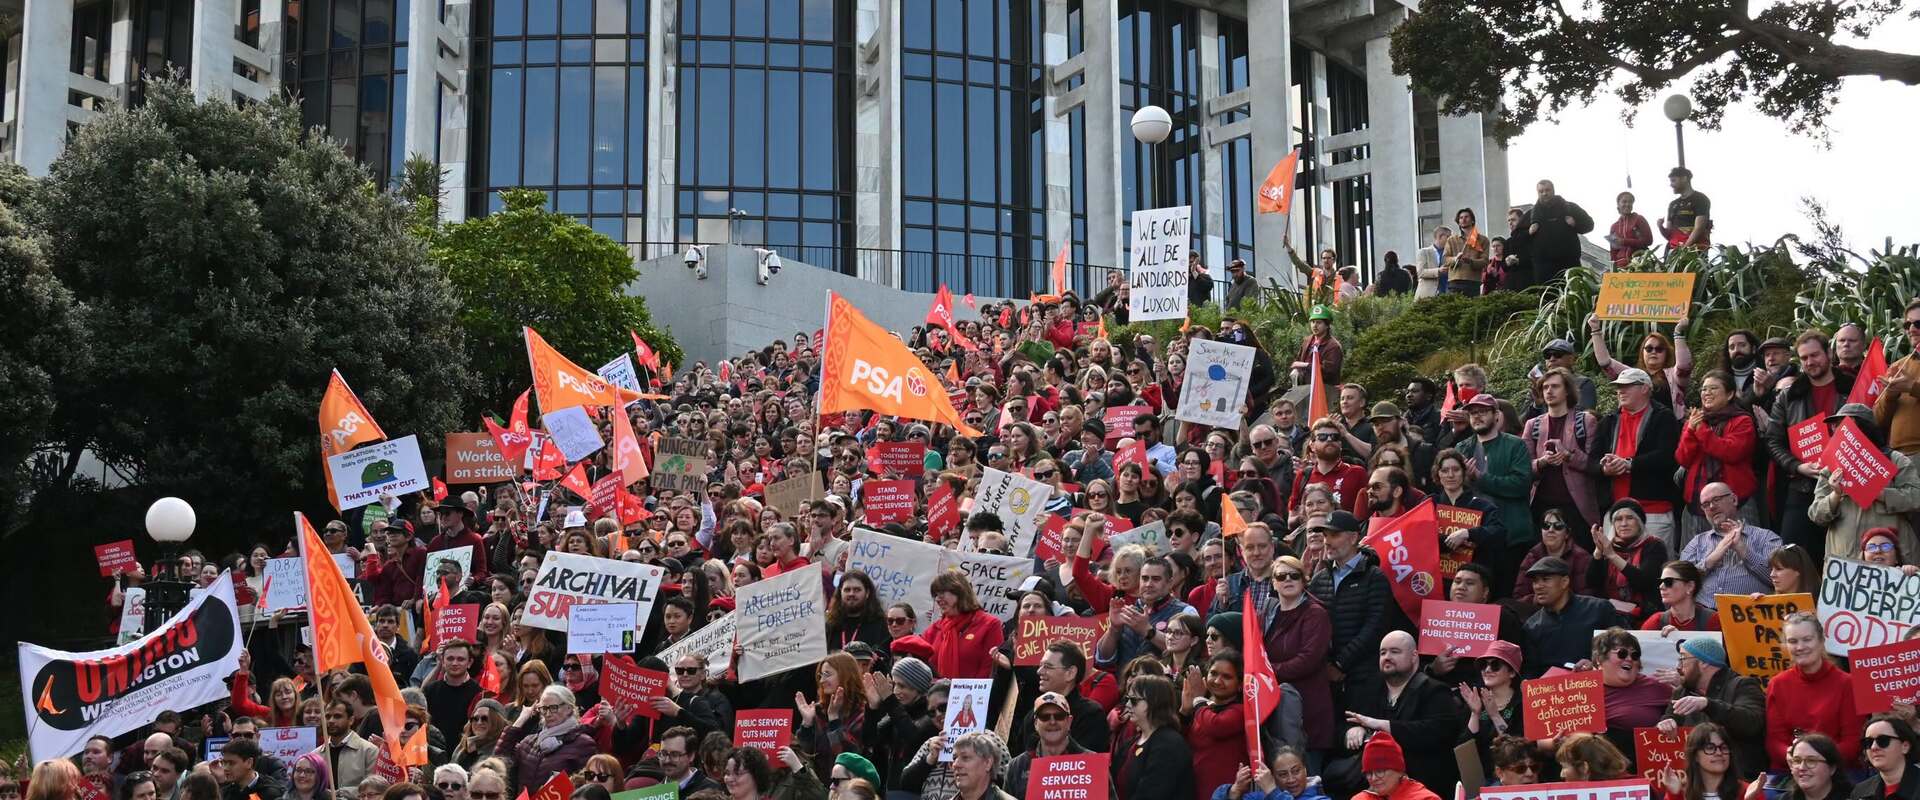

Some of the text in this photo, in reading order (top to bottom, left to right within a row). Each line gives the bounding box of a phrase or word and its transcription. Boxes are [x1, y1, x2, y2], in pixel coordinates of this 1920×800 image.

[1139, 215, 1157, 241] WE
[1138, 244, 1179, 267] ALL BE
[1131, 271, 1187, 289] LANDLORDS
[1142, 296, 1180, 313] LUXON
[558, 370, 596, 400] PSA
[850, 358, 903, 405] PSA
[1799, 422, 1817, 436] PUBLIC
[657, 437, 698, 456] HUNGRY
[1797, 433, 1822, 449] SERVICES
[457, 450, 505, 462] Worke
[1802, 445, 1823, 459] MATTER
[1840, 425, 1890, 479] PUBLIC SERVICE
[1840, 441, 1876, 478] CUTS HURT
[454, 465, 517, 478] on strike!
[1834, 450, 1868, 486] EVERYONE
[653, 472, 676, 489] FAIR
[344, 490, 373, 501] THAT'S
[382, 483, 398, 492] PAY
[938, 493, 953, 507] PUBLIC
[930, 506, 948, 523] SERVICES
[1437, 509, 1481, 528] THE LIBRARY
[854, 541, 891, 559] NOT
[1041, 536, 1061, 551] PUBLIC
[113, 557, 134, 565] SERVICES
[1382, 530, 1414, 583] PSA
[851, 561, 913, 586] ENOUGH
[960, 561, 1007, 581] SPACE
[536, 567, 651, 602] ARCHIVAL
[744, 583, 801, 616] ARCHIVES
[757, 601, 815, 632] FOREVER
[983, 602, 1009, 615] LIKE
[1445, 609, 1476, 619] STAND
[1023, 619, 1049, 638] DIA
[1051, 623, 1096, 640] underpays
[1427, 618, 1492, 631] TOGETHER FOR
[694, 632, 713, 648] HIGH
[714, 621, 738, 639] HORSES
[769, 629, 807, 646] NOT WITHOUT
[1421, 629, 1495, 641] PUBLIC SERVICES
[1016, 640, 1041, 659] GIVE
[1854, 654, 1896, 669] PUBLIC
[605, 659, 664, 688] PUBLIC SERVICE
[1870, 667, 1901, 680] CUTS
[153, 675, 183, 690] COUNCIL
[153, 690, 162, 698] OF
[164, 682, 187, 697] TRADE
[186, 673, 212, 686] UNIONS
[609, 673, 652, 694] CUTS HURT
[1564, 678, 1598, 690] Libraries
[610, 683, 649, 702] EVERYONE
[1531, 692, 1588, 709] are the only
[1537, 702, 1597, 722] data centres
[737, 718, 789, 727] PUBLIC SERVICE
[1544, 714, 1593, 737] I support
[742, 729, 778, 738] CUTS HURT
[1639, 731, 1651, 745] I
[1049, 760, 1086, 772] PUBLIC
[1042, 774, 1092, 786] SERVICES
[1044, 788, 1087, 799] MATTER
